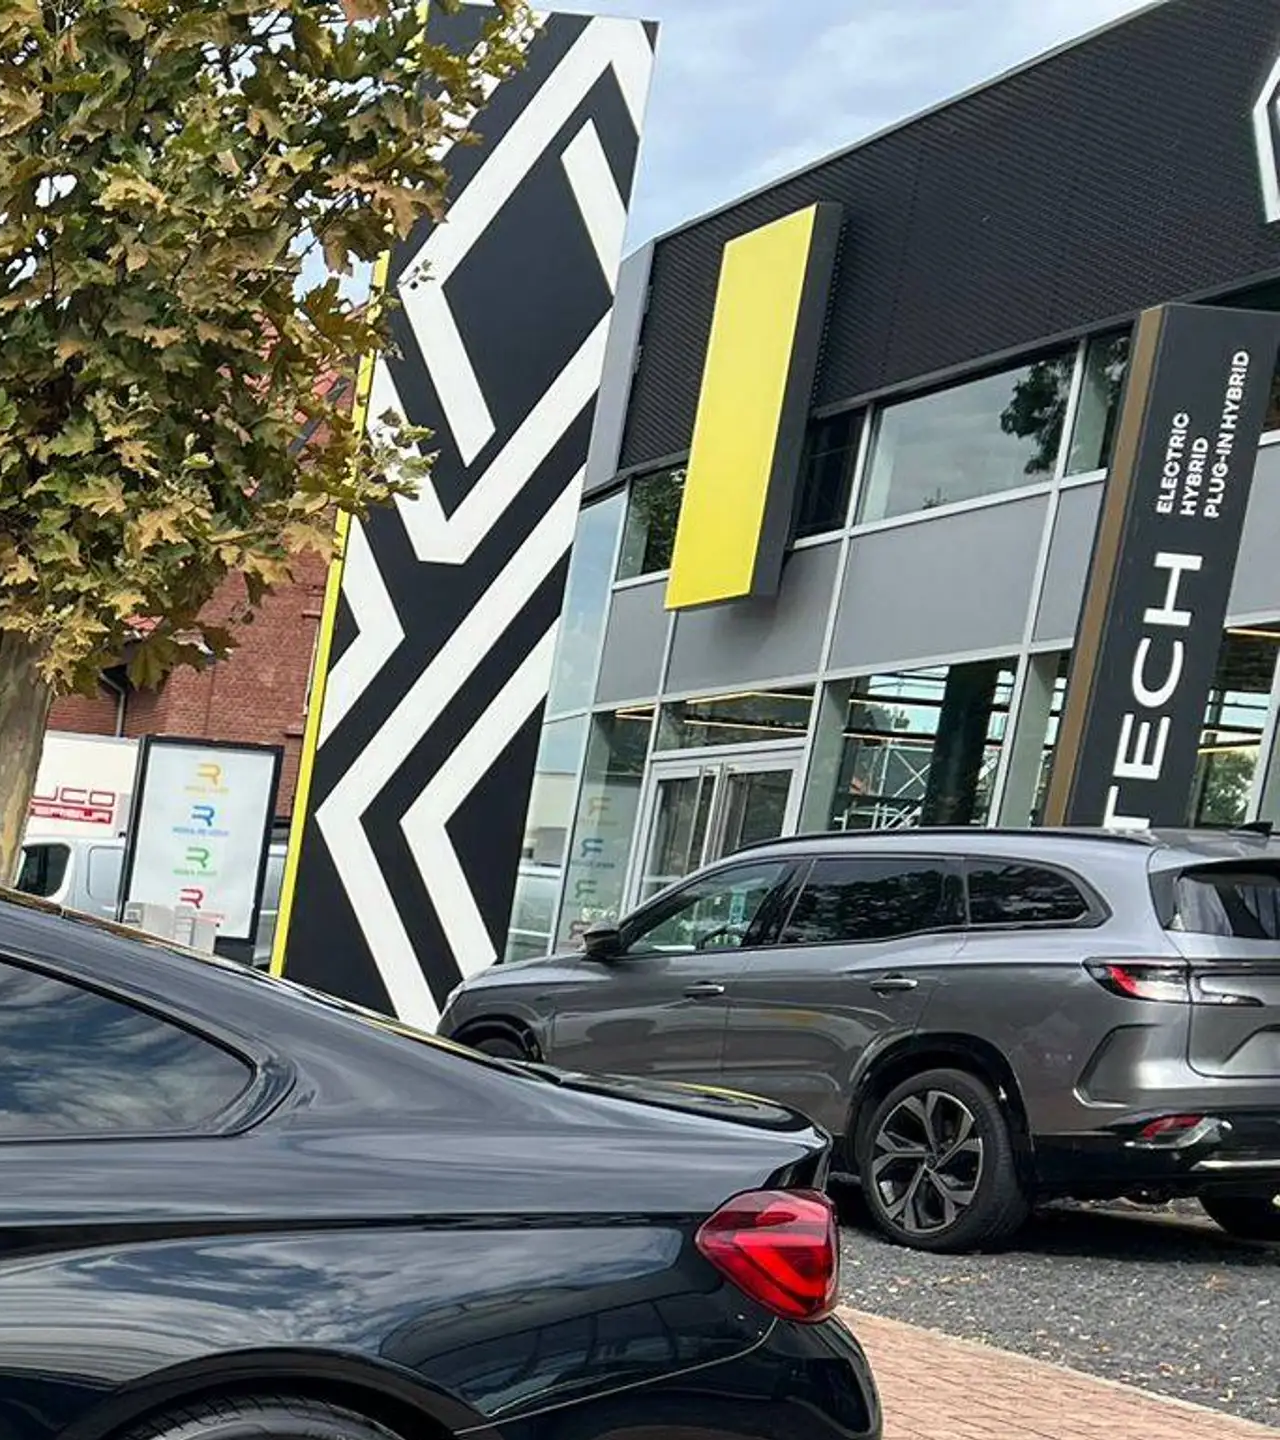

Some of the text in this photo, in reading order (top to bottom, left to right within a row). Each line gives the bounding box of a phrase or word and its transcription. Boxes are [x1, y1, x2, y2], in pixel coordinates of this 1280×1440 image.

[1156, 412, 1190, 514] ELECTRIC
[1180, 437, 1209, 516] HYBRID
[1203, 350, 1251, 519] PLUG-IN HYBRID
[1102, 551, 1204, 832] TECH
